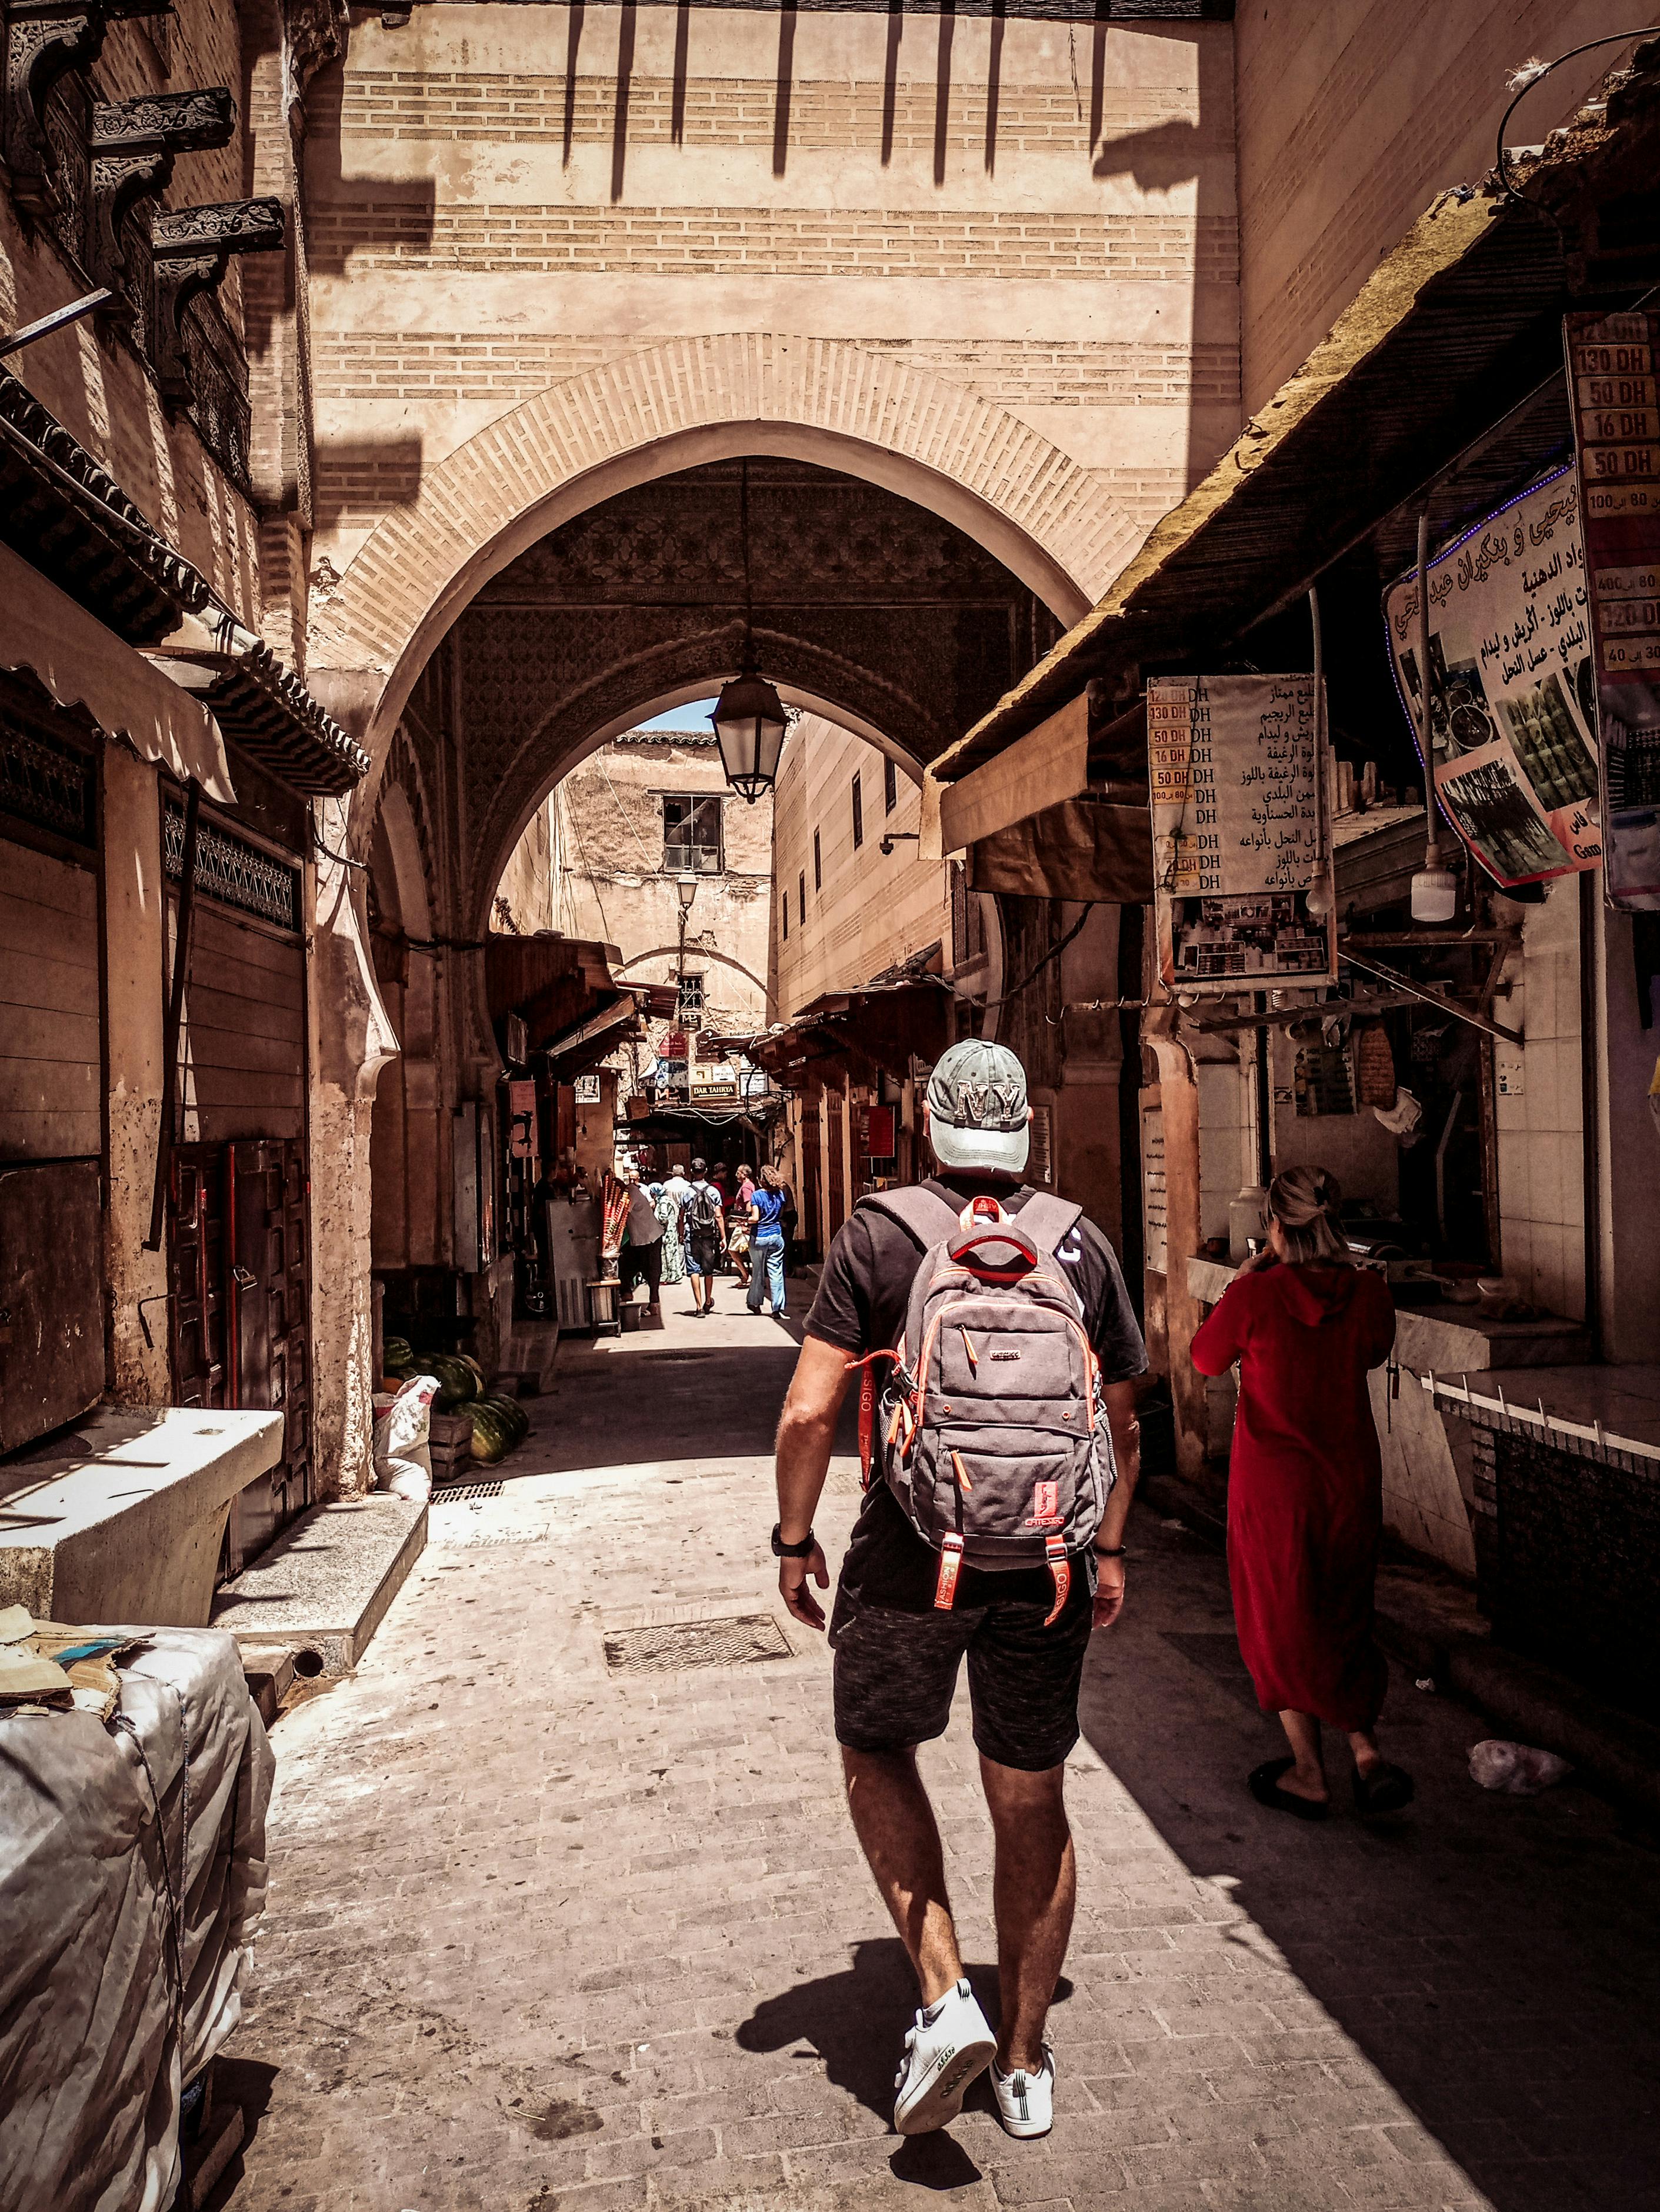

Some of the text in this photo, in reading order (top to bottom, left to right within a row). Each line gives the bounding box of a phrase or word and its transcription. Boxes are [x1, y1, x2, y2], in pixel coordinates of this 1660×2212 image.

[1578, 348, 1644, 372] 130 DH
[1589, 381, 1646, 404] 50 DH
[1594, 413, 1646, 436] 16 DH
[1595, 450, 1652, 475] 50 DH
[1590, 495, 1612, 509] 100
[1631, 493, 1647, 506] 80
[1514, 527, 1524, 556] و
[1522, 552, 1562, 598] الدهنية
[1639, 574, 1656, 588] 80
[1395, 585, 1420, 642] لحي
[1547, 592, 1575, 628] باللوز
[1503, 635, 1509, 652] و
[1502, 620, 1587, 685] البلدي عسل النحل
[1609, 648, 1625, 662] 40
[1188, 688, 1209, 702] DH
[1269, 685, 1294, 703] ممتاز
[1150, 706, 1186, 719] 130 DH
[1190, 708, 1211, 722] DH
[1154, 729, 1186, 743] 50 DH
[1191, 728, 1212, 743] DH
[1155, 749, 1185, 763] 16 DH
[1191, 748, 1212, 763] DH
[1158, 771, 1189, 785] 50 DH
[1194, 769, 1214, 784] DH
[1241, 766, 1265, 786] باللوز
[1152, 791, 1165, 800] 100
[1195, 789, 1216, 804] DH
[1262, 785, 1293, 804] البلدي
[1196, 809, 1216, 824] DH
[1198, 834, 1218, 849] DH
[1274, 829, 1301, 848] النحل
[1304, 829, 1328, 848] عل
[1200, 854, 1221, 869] DH
[1275, 850, 1300, 869] باللوز
[1200, 875, 1221, 889] DH
[954, 1080, 1021, 1122] NY
[939, 1566, 951, 1600] ASHION
